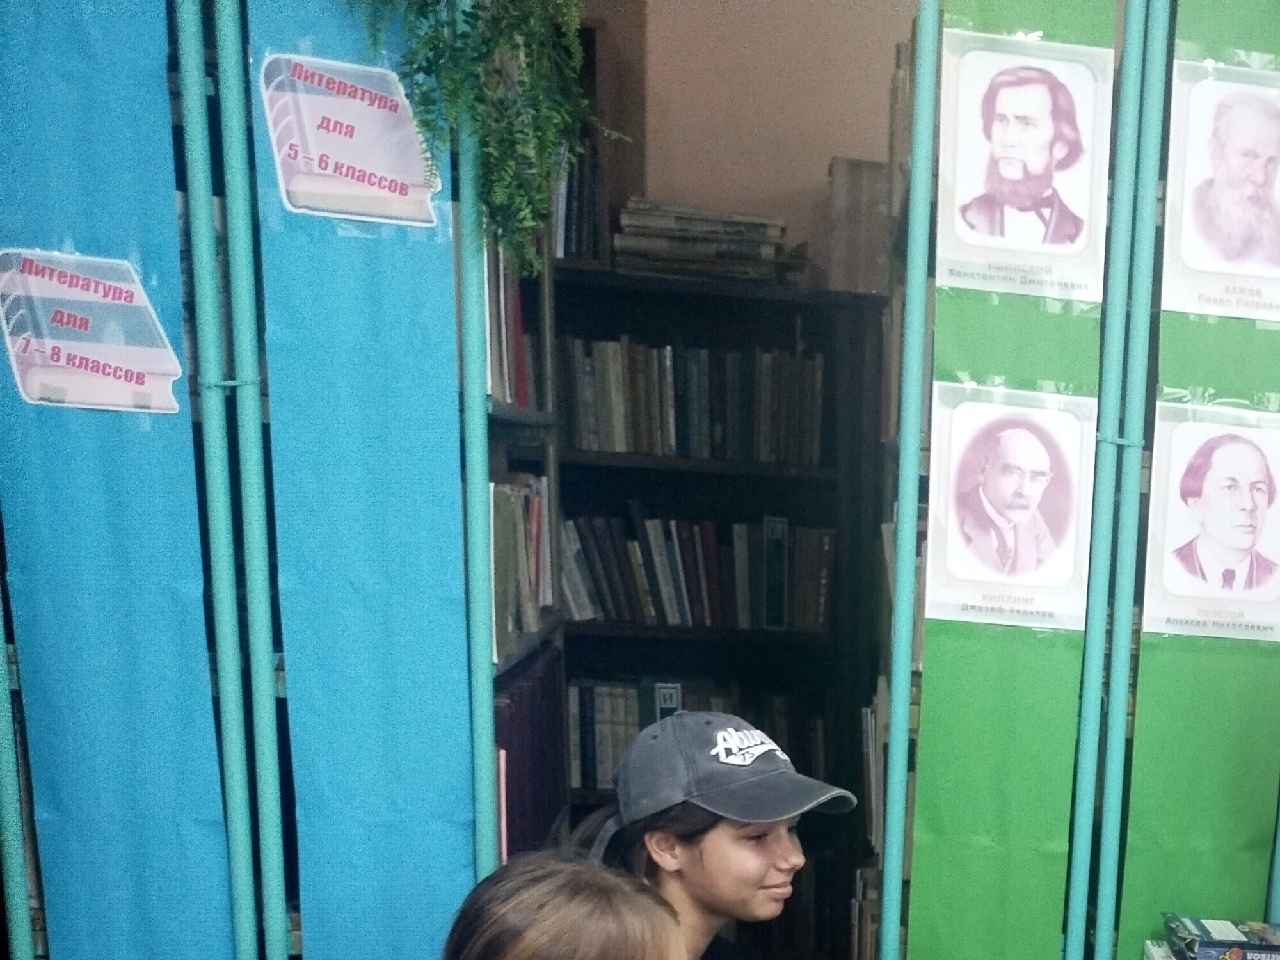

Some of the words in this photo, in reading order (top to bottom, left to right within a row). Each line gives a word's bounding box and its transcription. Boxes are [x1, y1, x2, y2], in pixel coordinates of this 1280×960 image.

[290, 62, 400, 113] Литература
[317, 116, 355, 139] для
[287, 143, 299, 161] 5
[318, 153, 330, 171] 6
[333, 161, 409, 196] классов
[20, 257, 135, 303] Литература
[50, 309, 90, 331] для
[21, 337, 31, 354] 7
[50, 345, 62, 363] 8
[66, 352, 146, 386] классов
[1212, 620, 1275, 632] Николаевич
